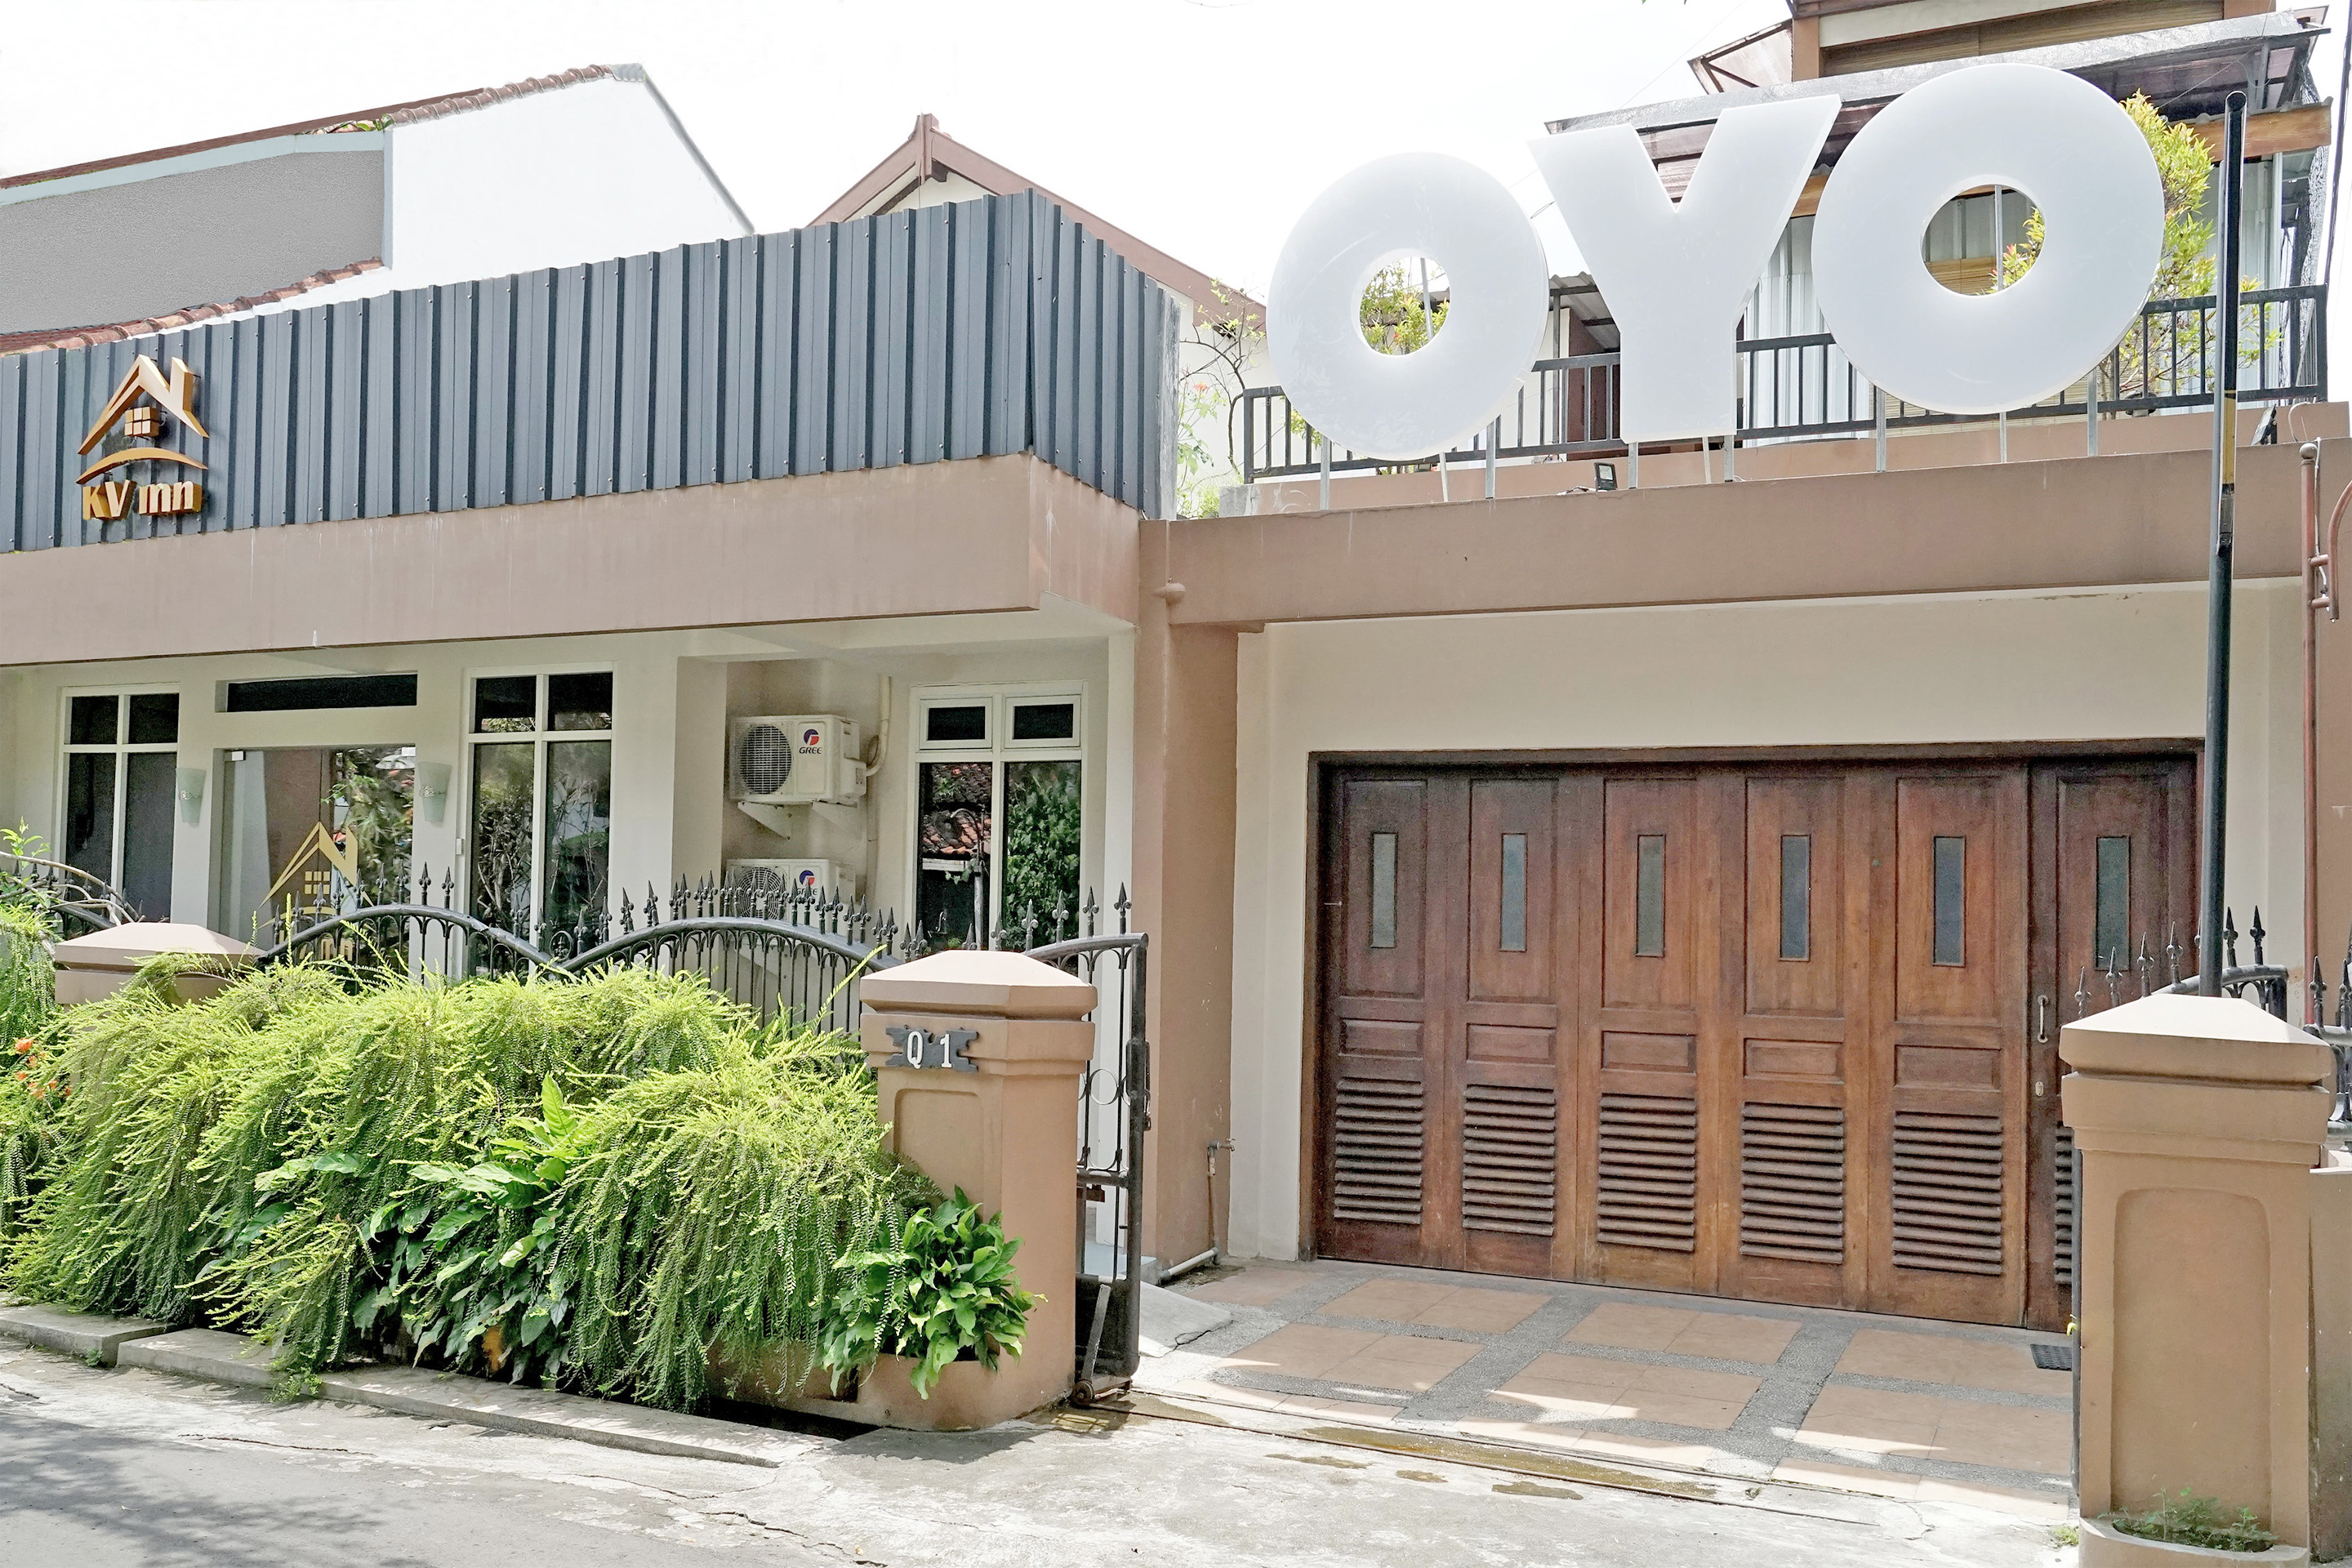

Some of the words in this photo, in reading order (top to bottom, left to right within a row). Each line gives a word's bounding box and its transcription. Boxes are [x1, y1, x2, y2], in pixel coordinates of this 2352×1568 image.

[1267, 62, 2165, 461] OYO
[82, 479, 133, 520] KV
[799, 746, 822, 755] GREE
